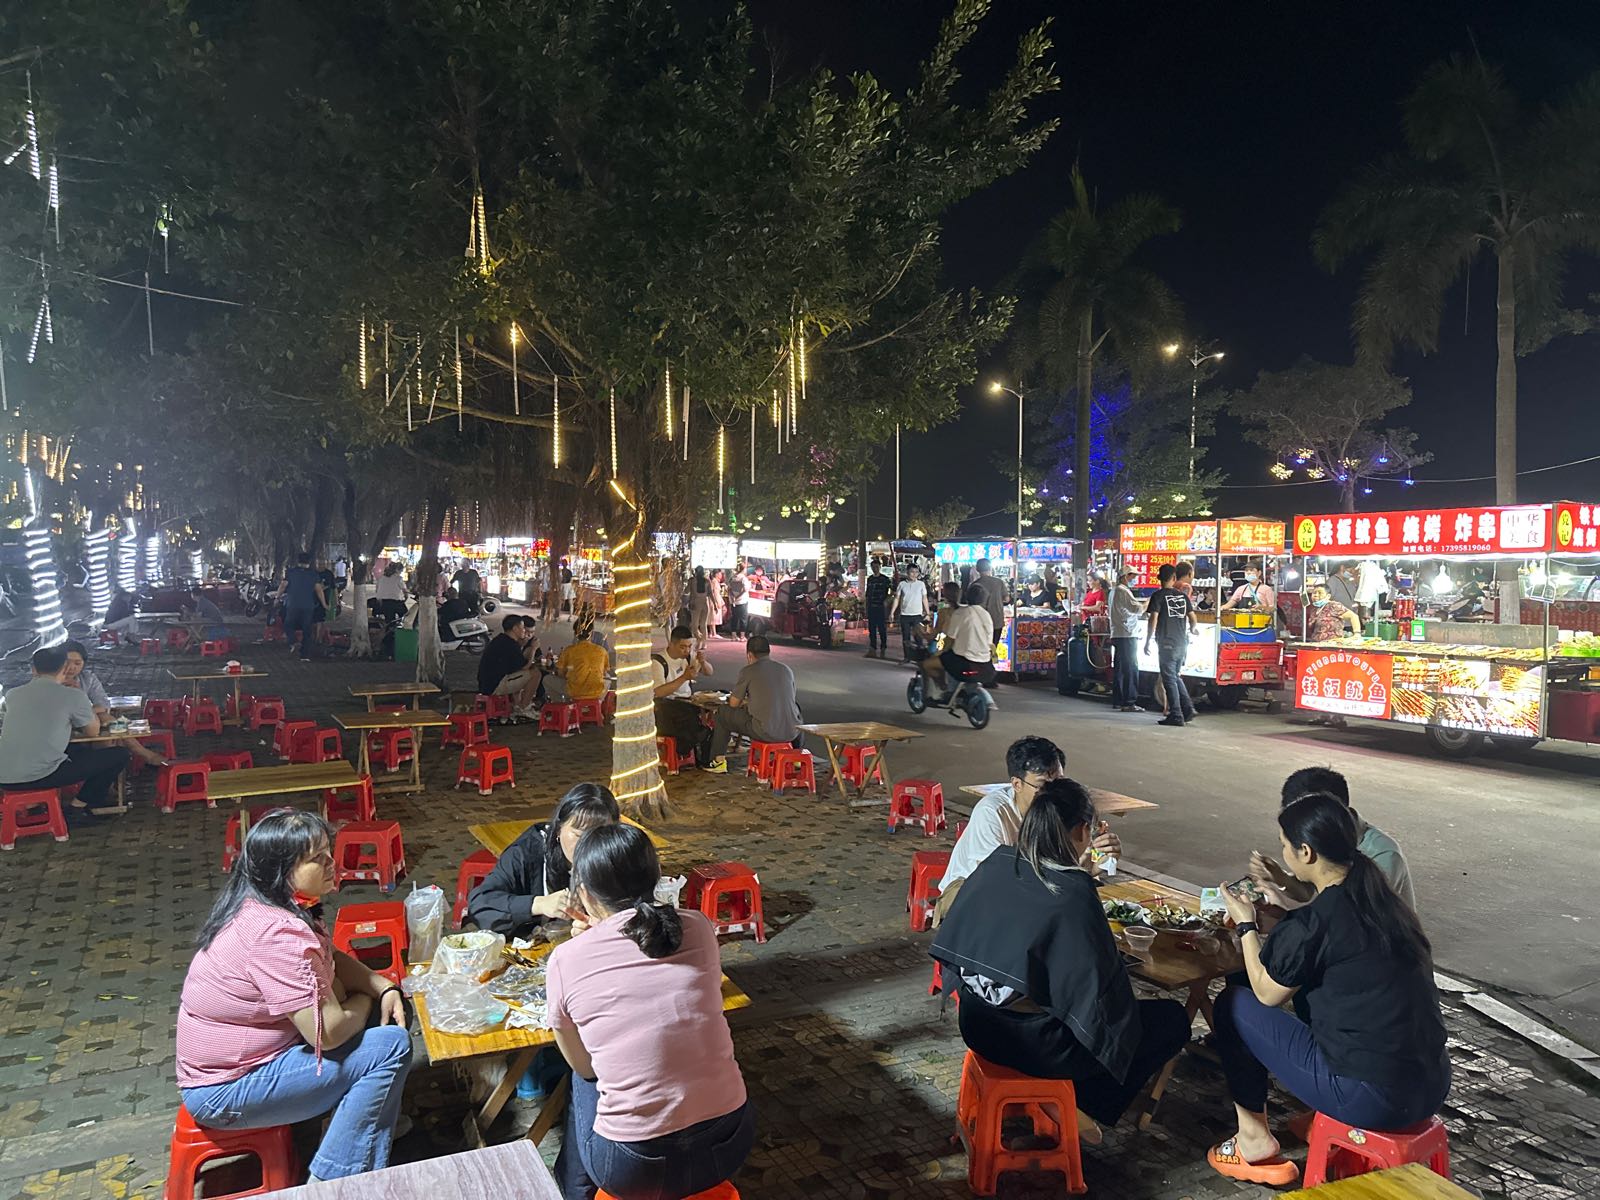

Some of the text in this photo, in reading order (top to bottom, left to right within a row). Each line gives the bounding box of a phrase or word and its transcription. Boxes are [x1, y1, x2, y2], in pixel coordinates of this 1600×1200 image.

[1222, 523, 1283, 545] 北海生蚝
[1318, 517, 1390, 546] 铁板鱿鱼
[1454, 512, 1496, 543] 炸串
[1440, 544, 1491, 552] 17395819060
[1302, 676, 1386, 703] 铁板鱿鱼
